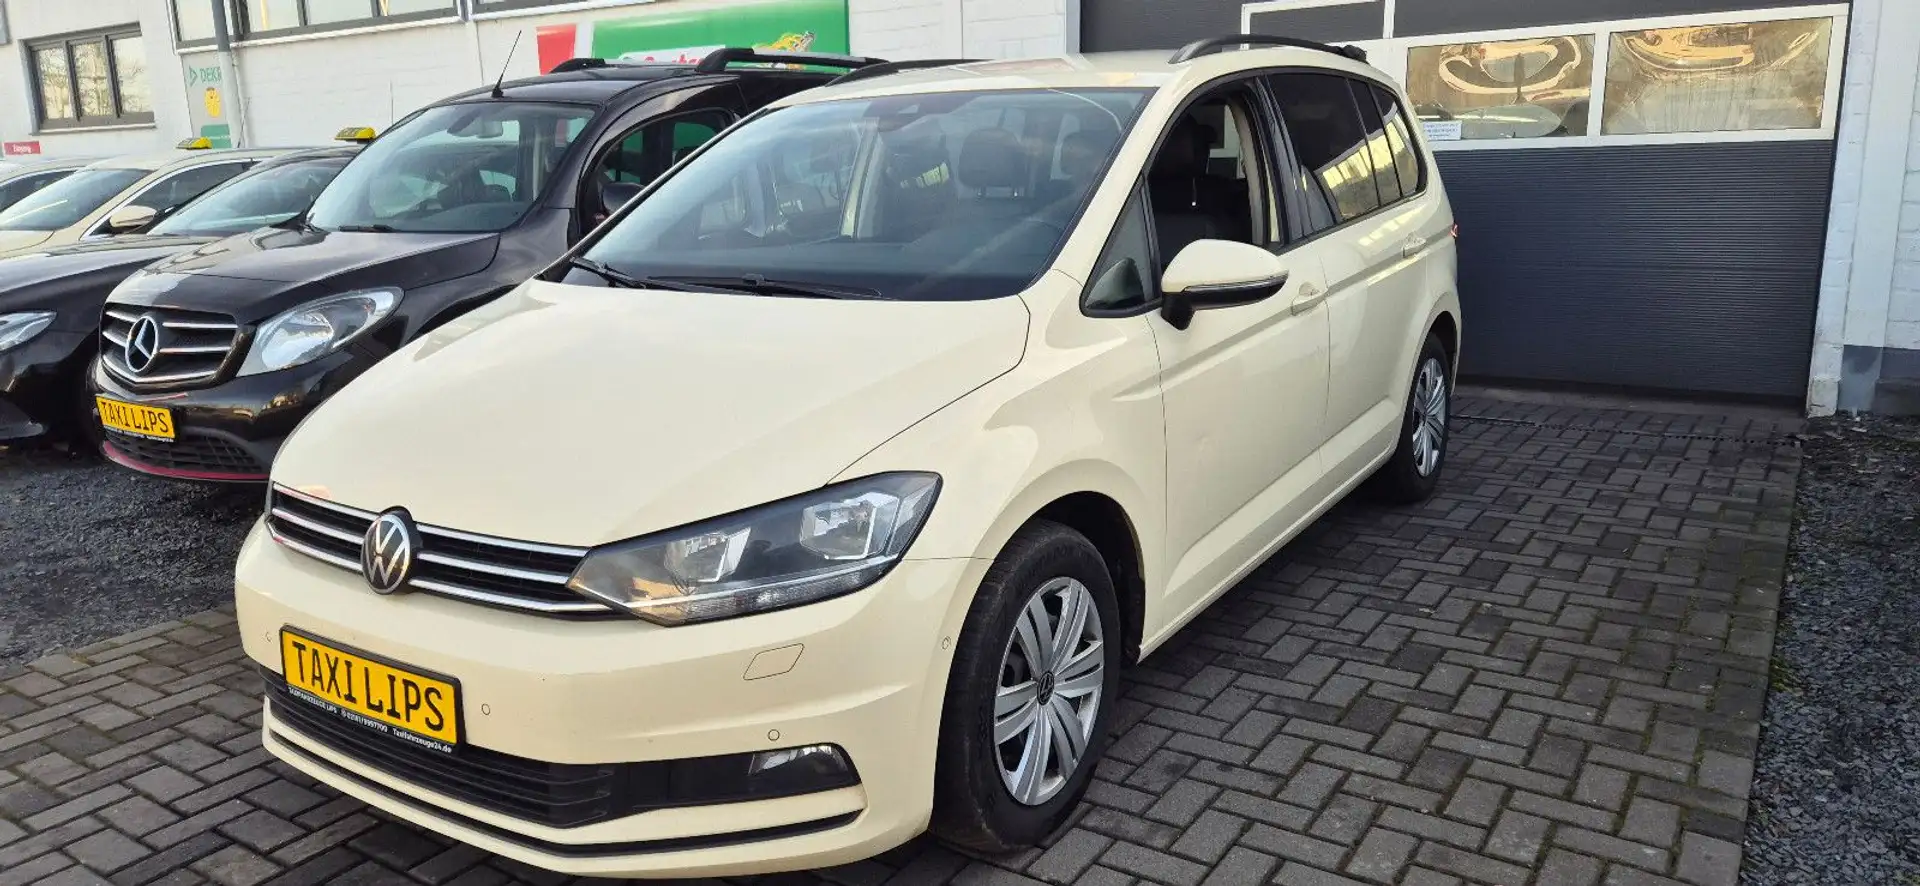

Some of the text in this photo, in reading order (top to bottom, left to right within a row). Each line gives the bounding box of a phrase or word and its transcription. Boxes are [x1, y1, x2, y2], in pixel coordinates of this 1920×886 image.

[200, 66, 221, 83] DEKR
[101, 401, 169, 433] TAXI LIPS
[292, 641, 444, 731] TAXI LIPS
